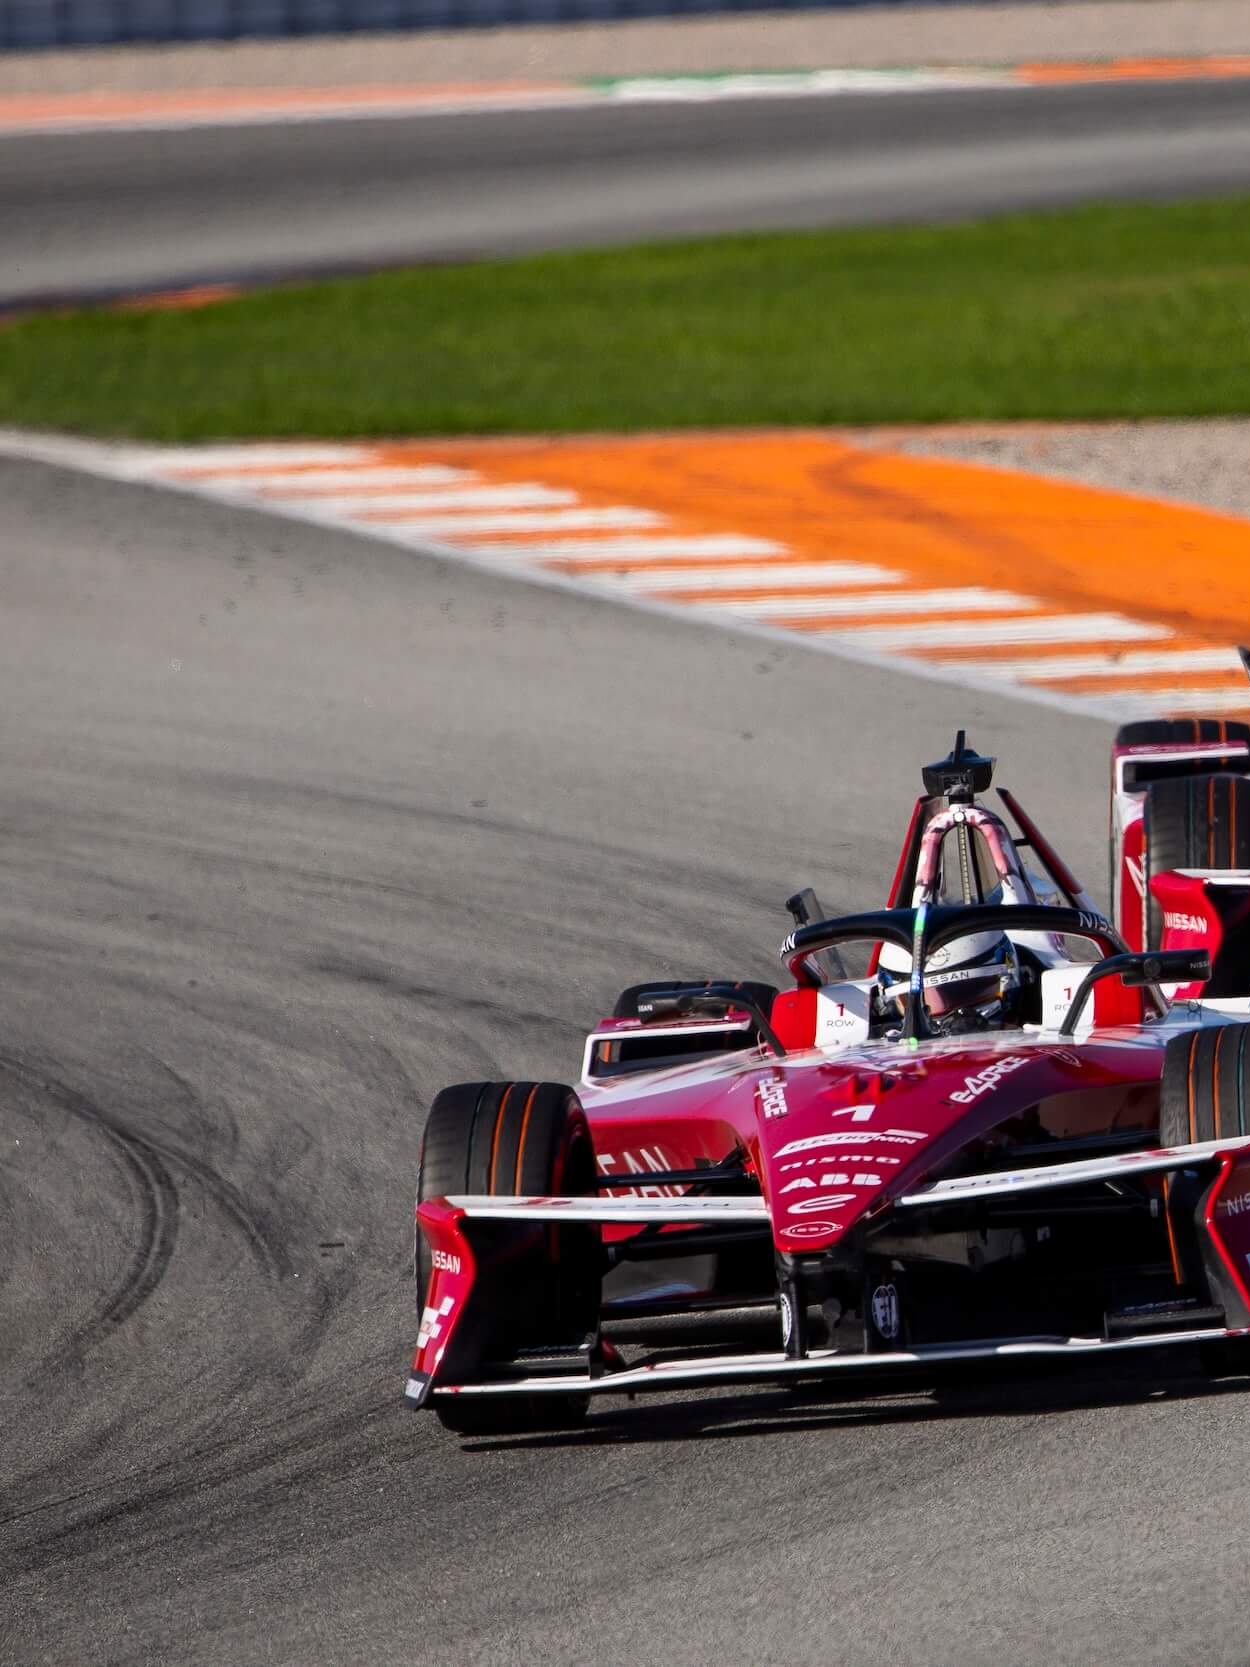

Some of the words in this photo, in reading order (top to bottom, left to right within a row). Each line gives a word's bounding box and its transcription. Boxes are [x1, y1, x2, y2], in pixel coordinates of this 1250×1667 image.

[1063, 987, 1072, 1001] 1
[836, 1003, 845, 1017] 1
[826, 1018, 855, 1028] ROW
[832, 1104, 876, 1122] 1
[779, 1173, 883, 1194] ABB
